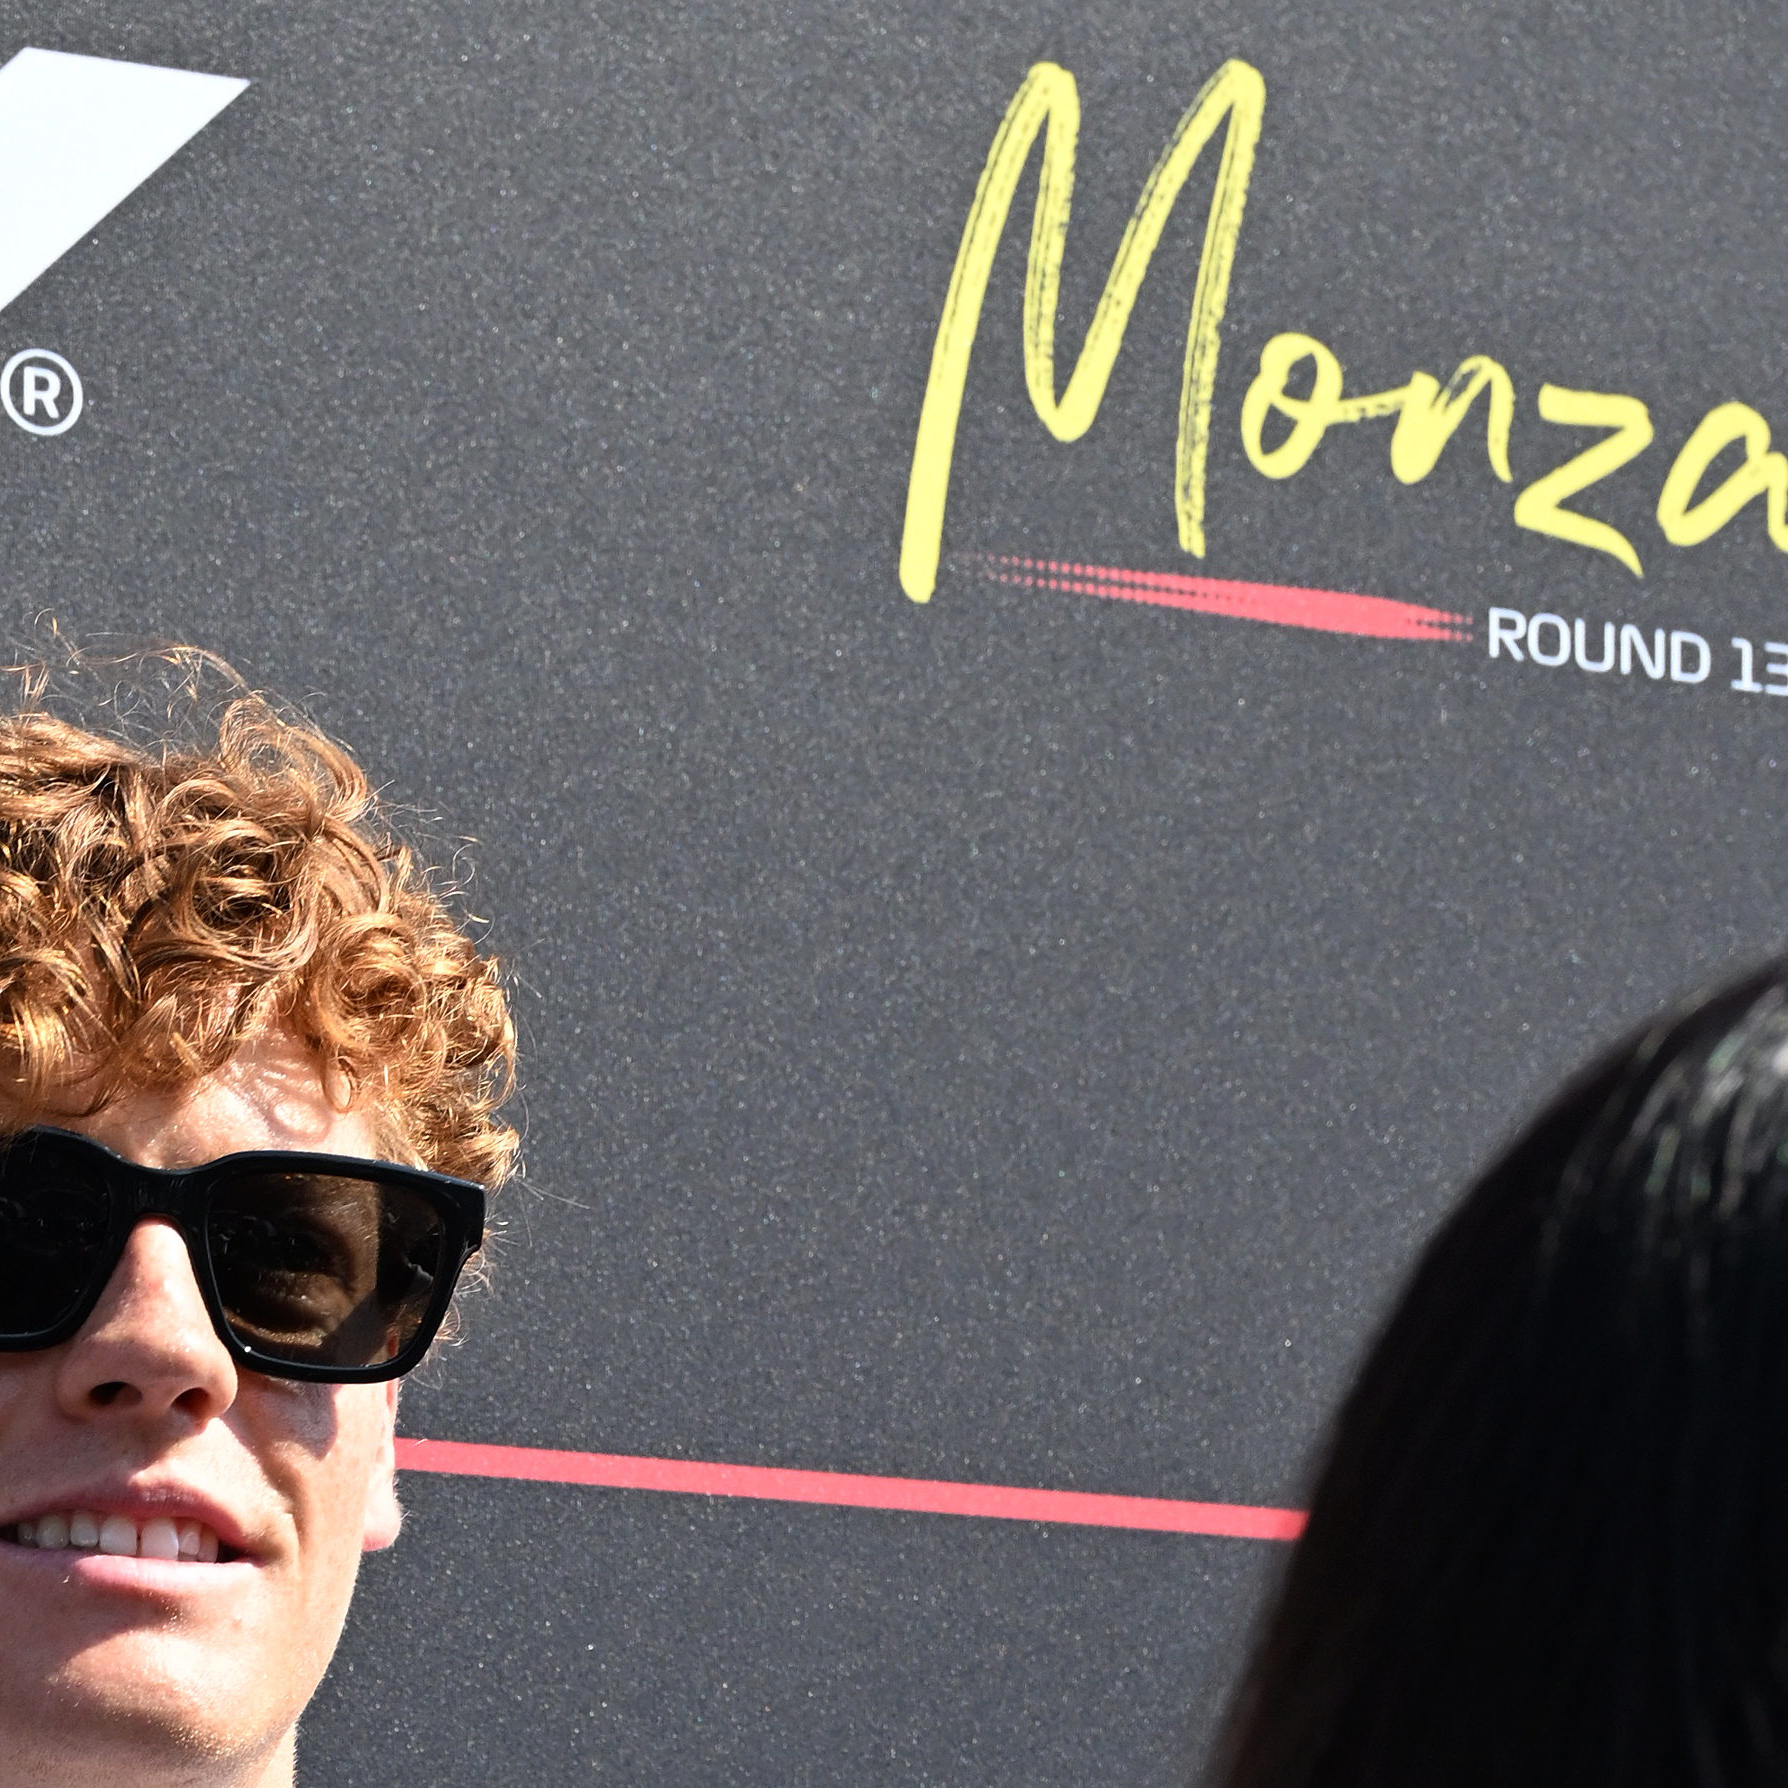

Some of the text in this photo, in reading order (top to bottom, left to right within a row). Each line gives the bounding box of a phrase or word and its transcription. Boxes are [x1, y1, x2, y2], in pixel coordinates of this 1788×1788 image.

[898, 58, 1788, 604] Monza
[1488, 606, 1788, 697] ROUND 13
